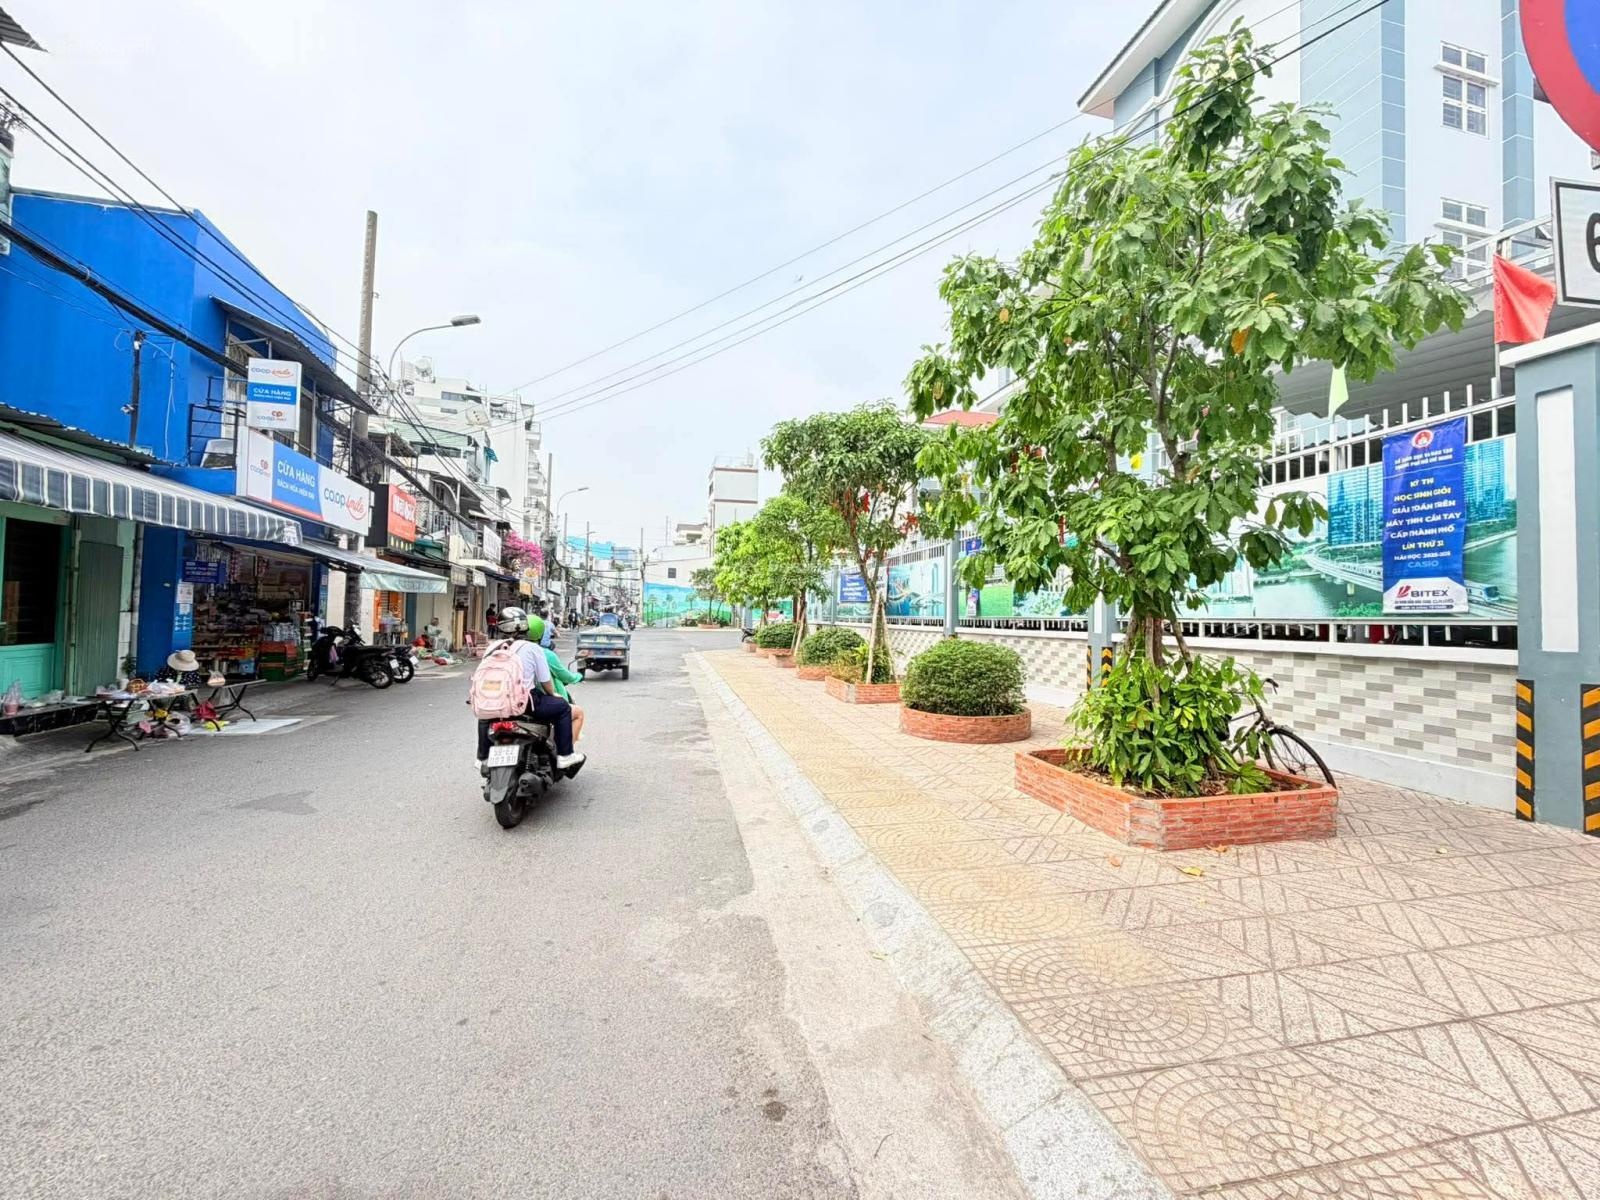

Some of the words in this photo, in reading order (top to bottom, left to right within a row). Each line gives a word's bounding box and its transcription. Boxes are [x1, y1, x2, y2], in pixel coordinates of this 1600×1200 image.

[270, 388, 292, 397] HÀNG
[295, 466, 316, 488] HÀNG
[1413, 490, 1433, 499] SINH
[1411, 502, 1433, 512] TOÁN
[1386, 518, 1404, 528] MÁY
[1442, 512, 1462, 520] TAY
[1409, 528, 1437, 537] THÀNH
[1408, 560, 1440, 569] CASIO
[1410, 589, 1449, 597] BITEX
